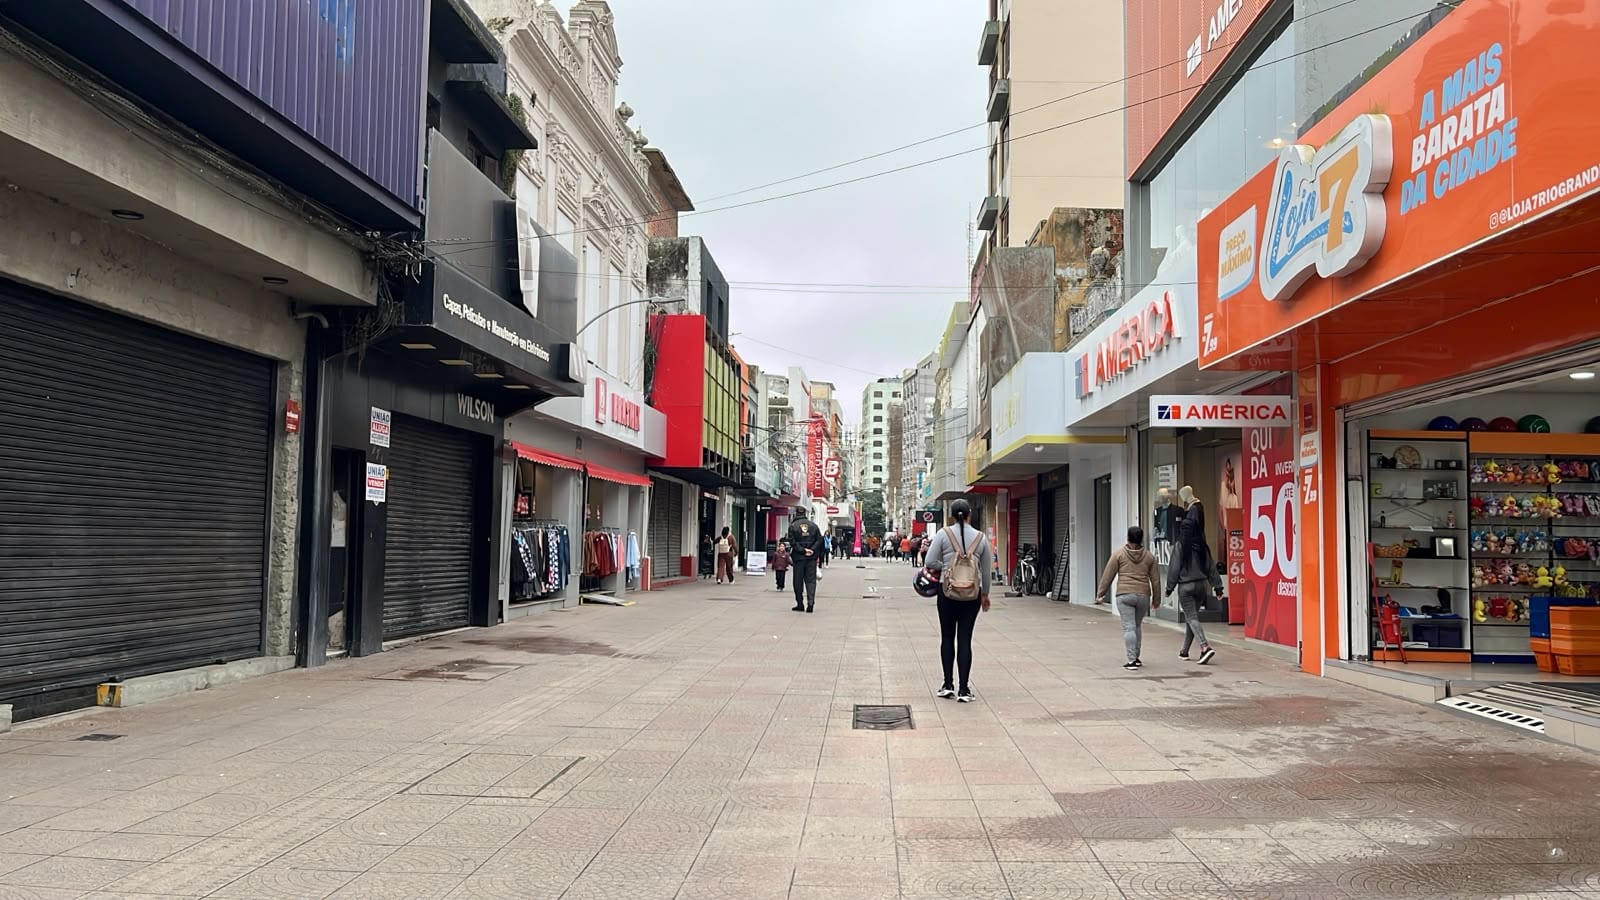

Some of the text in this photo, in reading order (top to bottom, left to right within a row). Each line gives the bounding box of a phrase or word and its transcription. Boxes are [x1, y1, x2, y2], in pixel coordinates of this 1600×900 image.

[1420, 42, 1502, 130] A MAIS
[1411, 83, 1505, 173] BARATA
[1319, 145, 1359, 253] 7
[1400, 117, 1518, 216] DA CIDADE
[1499, 163, 1600, 224] @LOJA7RIOGRAND
[1220, 245, 1252, 279] MÁXIMO
[1225, 229, 1247, 254] PREÇO
[1096, 291, 1180, 387] AMÉRICA
[457, 392, 495, 424] WILSON
[1186, 403, 1287, 420] AMÉRICA
[1251, 455, 1268, 480] DA
[1249, 482, 1297, 579] 50
